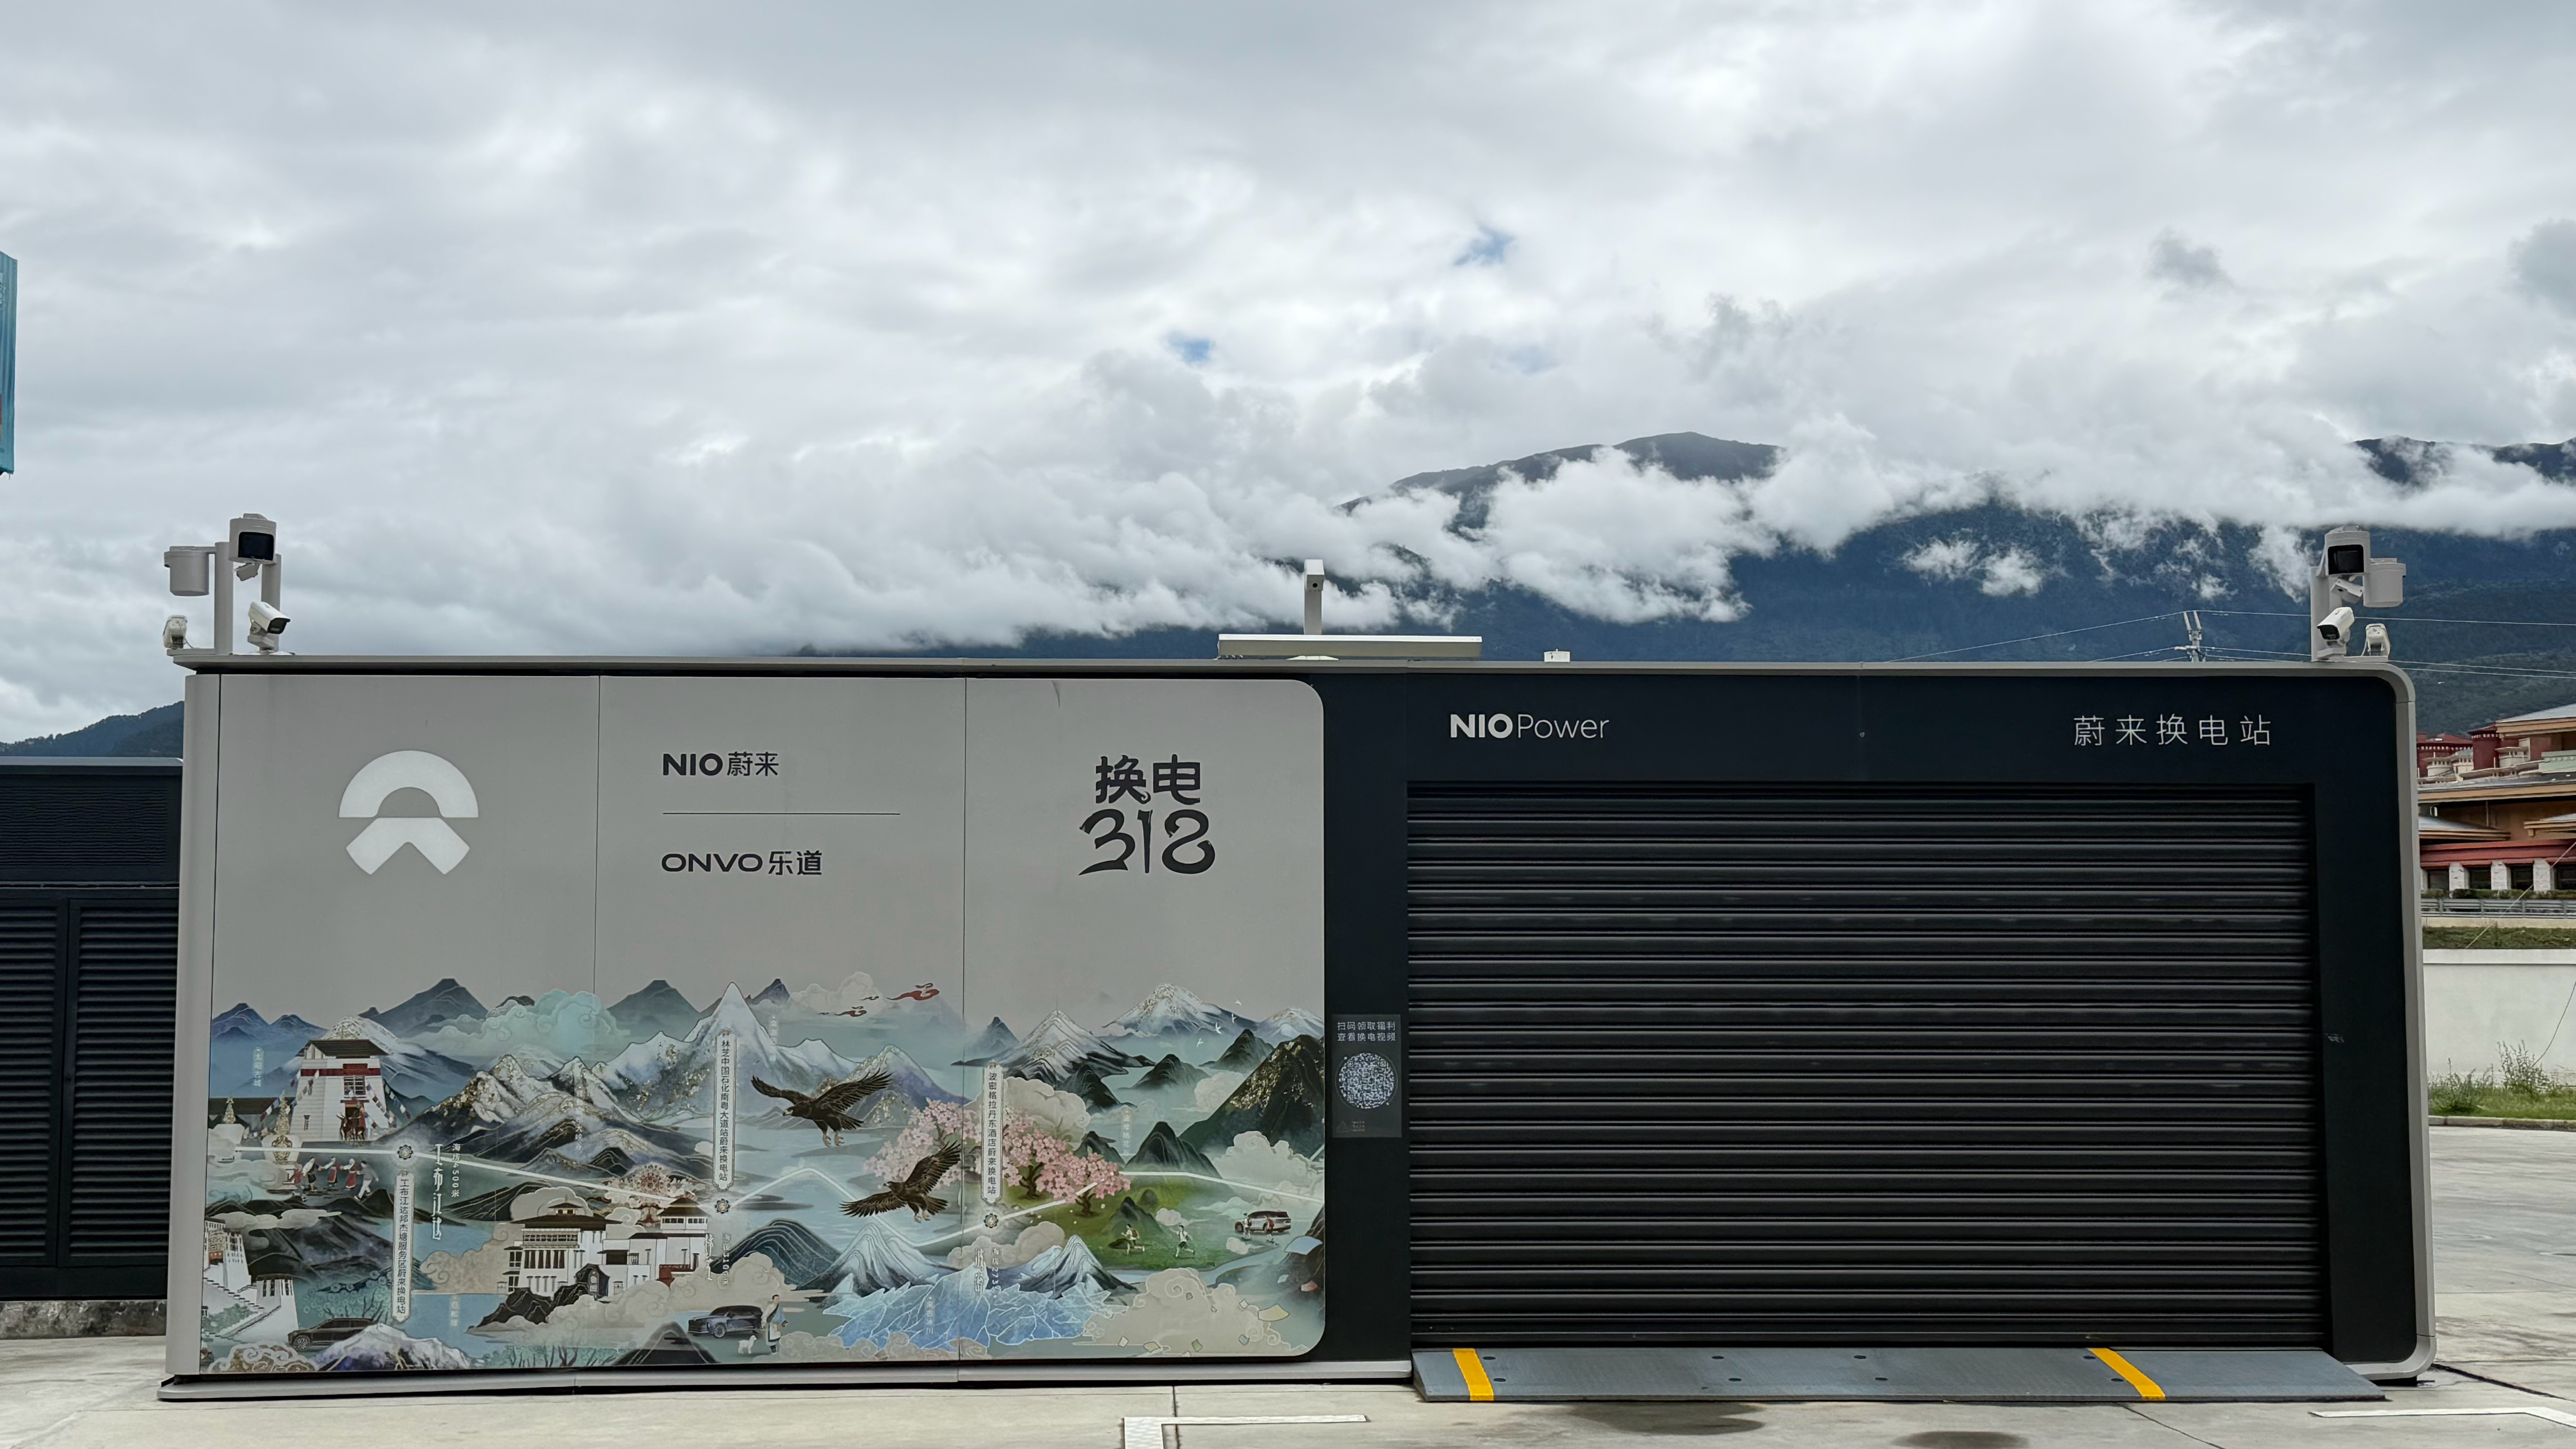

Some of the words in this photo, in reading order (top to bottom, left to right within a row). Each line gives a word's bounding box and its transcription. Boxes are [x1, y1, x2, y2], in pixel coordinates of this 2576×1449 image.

[1450, 713, 1513, 738] NIO
[1518, 714, 1609, 738] Power
[2074, 713, 2271, 746] 蔚来换电站
[663, 753, 723, 776] NIO
[727, 751, 779, 777] 蔚来
[1095, 754, 1201, 805] 换电
[1078, 809, 1215, 875] 318
[661, 853, 763, 872] ONVO
[768, 850, 822, 875] 乐道
[1337, 1021, 1395, 1030] 扫码领取福利
[1337, 1032, 1396, 1041] 查看换电视频
